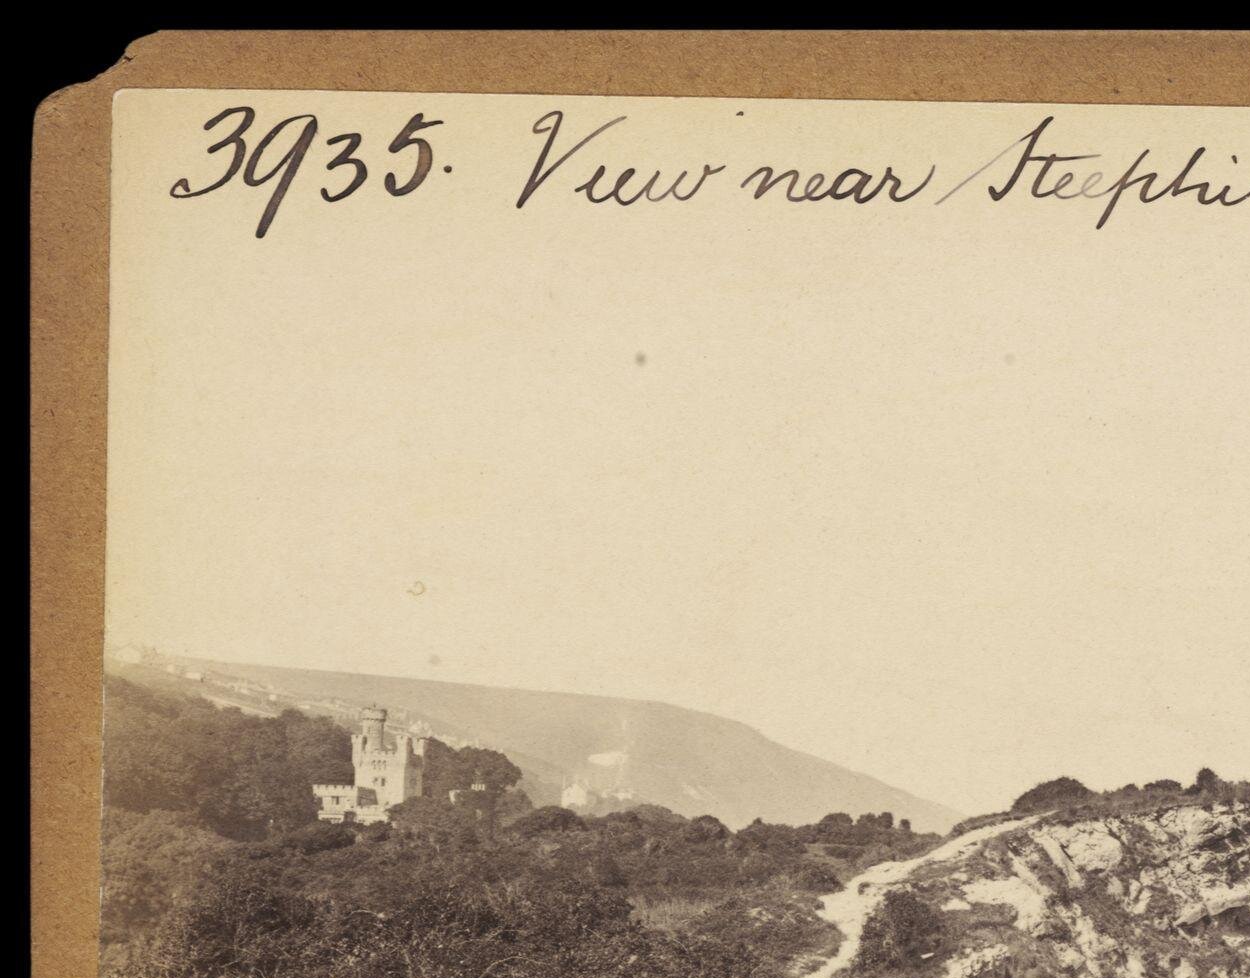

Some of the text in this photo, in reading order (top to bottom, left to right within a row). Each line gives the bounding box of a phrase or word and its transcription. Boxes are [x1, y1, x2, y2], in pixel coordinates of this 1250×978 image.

[170, 106, 453, 240] 3935.
[514, 110, 728, 210] View
[740, 164, 936, 205] near
